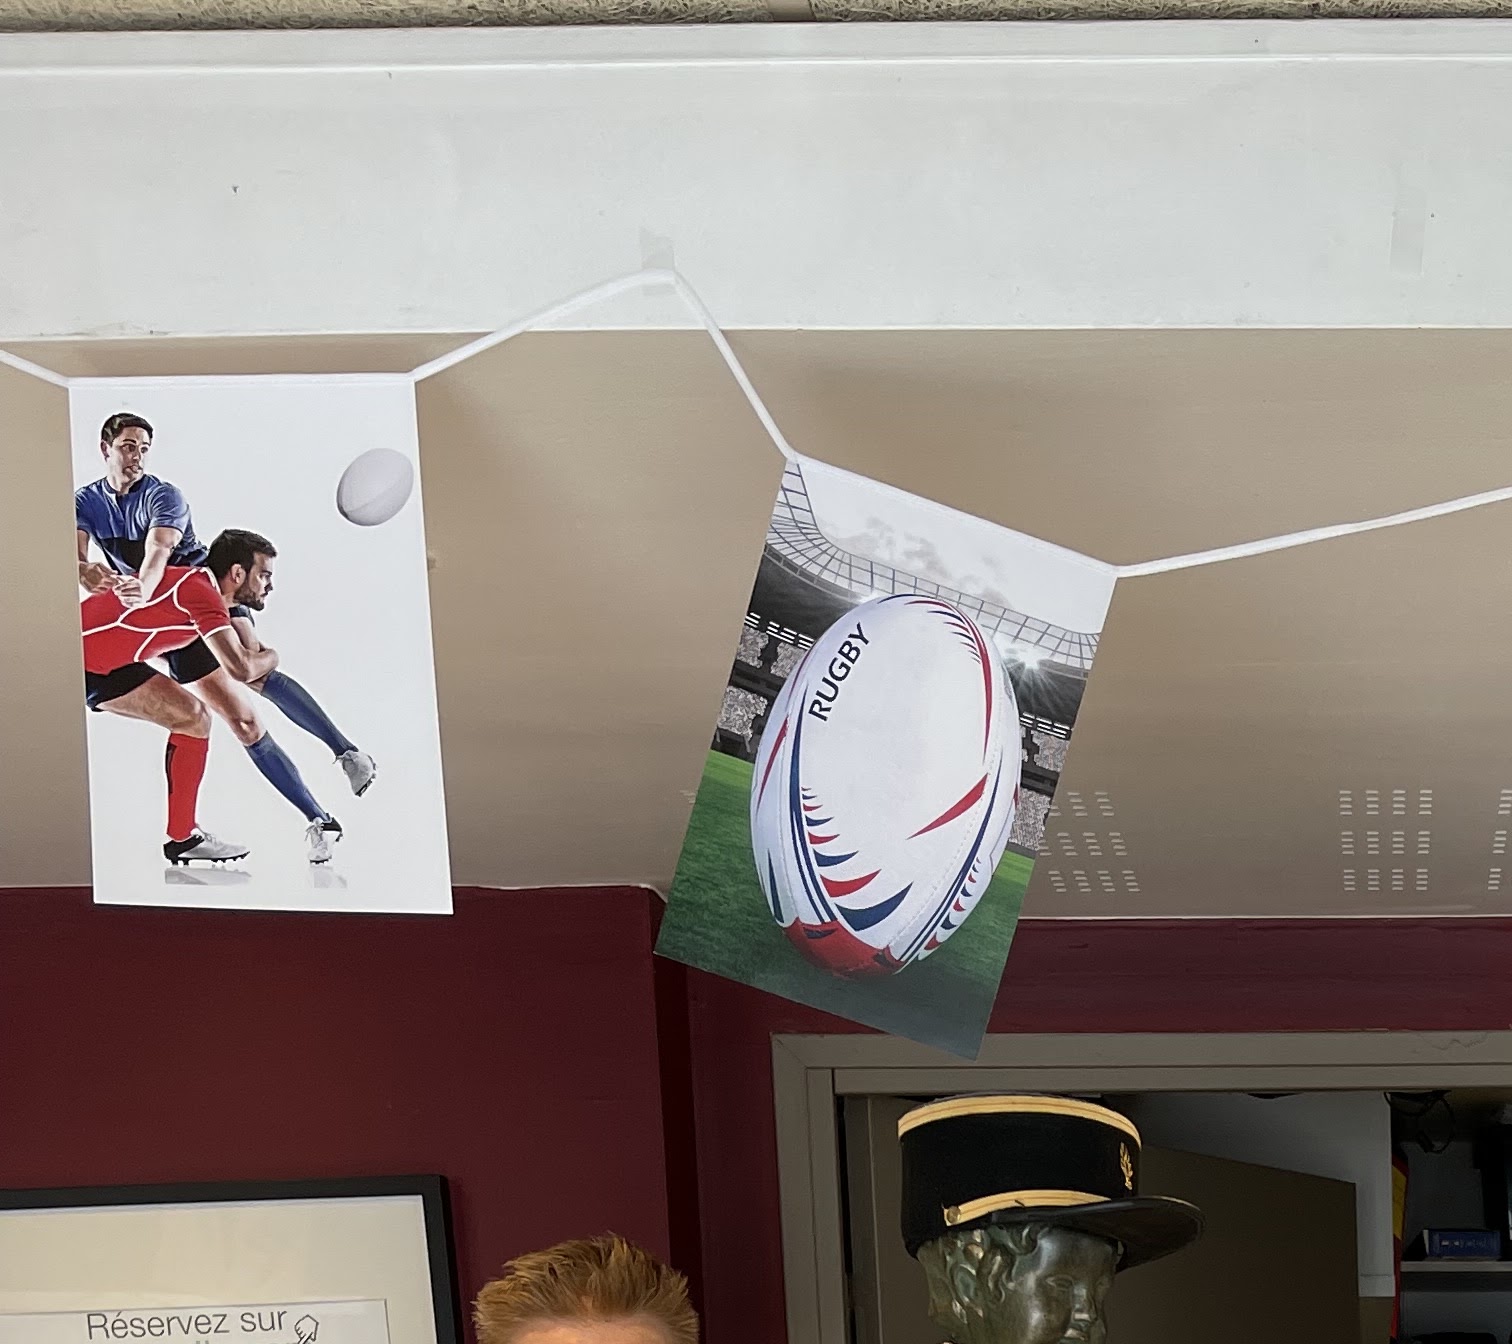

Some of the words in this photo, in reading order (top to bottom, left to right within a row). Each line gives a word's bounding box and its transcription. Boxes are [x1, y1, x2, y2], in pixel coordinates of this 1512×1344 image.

[808, 621, 871, 722] RUGBY
[86, 1311, 230, 1340] Réservez
[241, 1310, 287, 1332] sur
